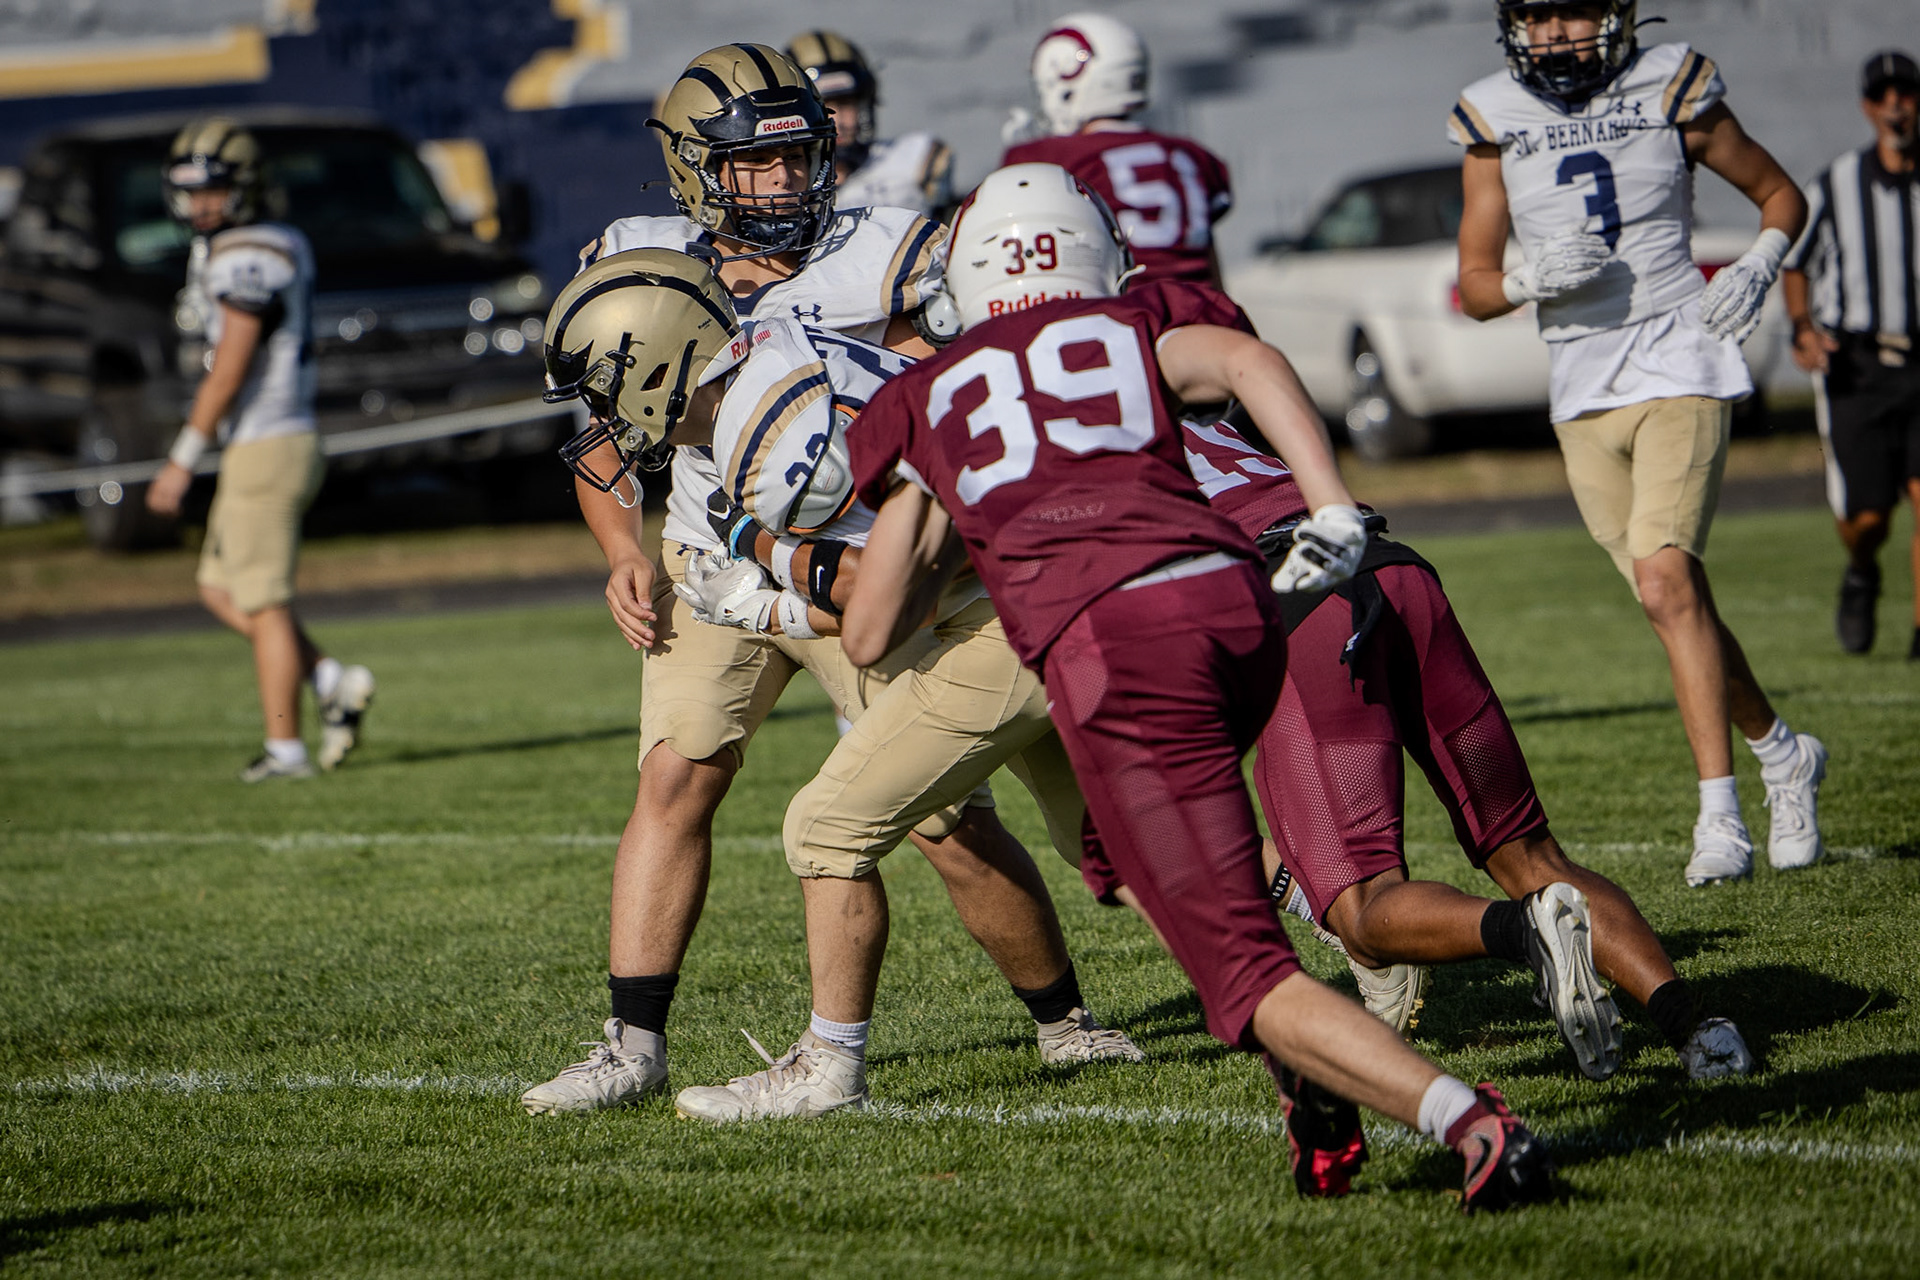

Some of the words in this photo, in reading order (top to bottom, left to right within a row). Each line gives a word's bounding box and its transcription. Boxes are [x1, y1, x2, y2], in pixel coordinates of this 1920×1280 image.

[763, 118, 804, 132] Riddell
[1101, 142, 1209, 248] 51
[1556, 151, 1622, 250] 3
[926, 313, 1155, 507] 39
